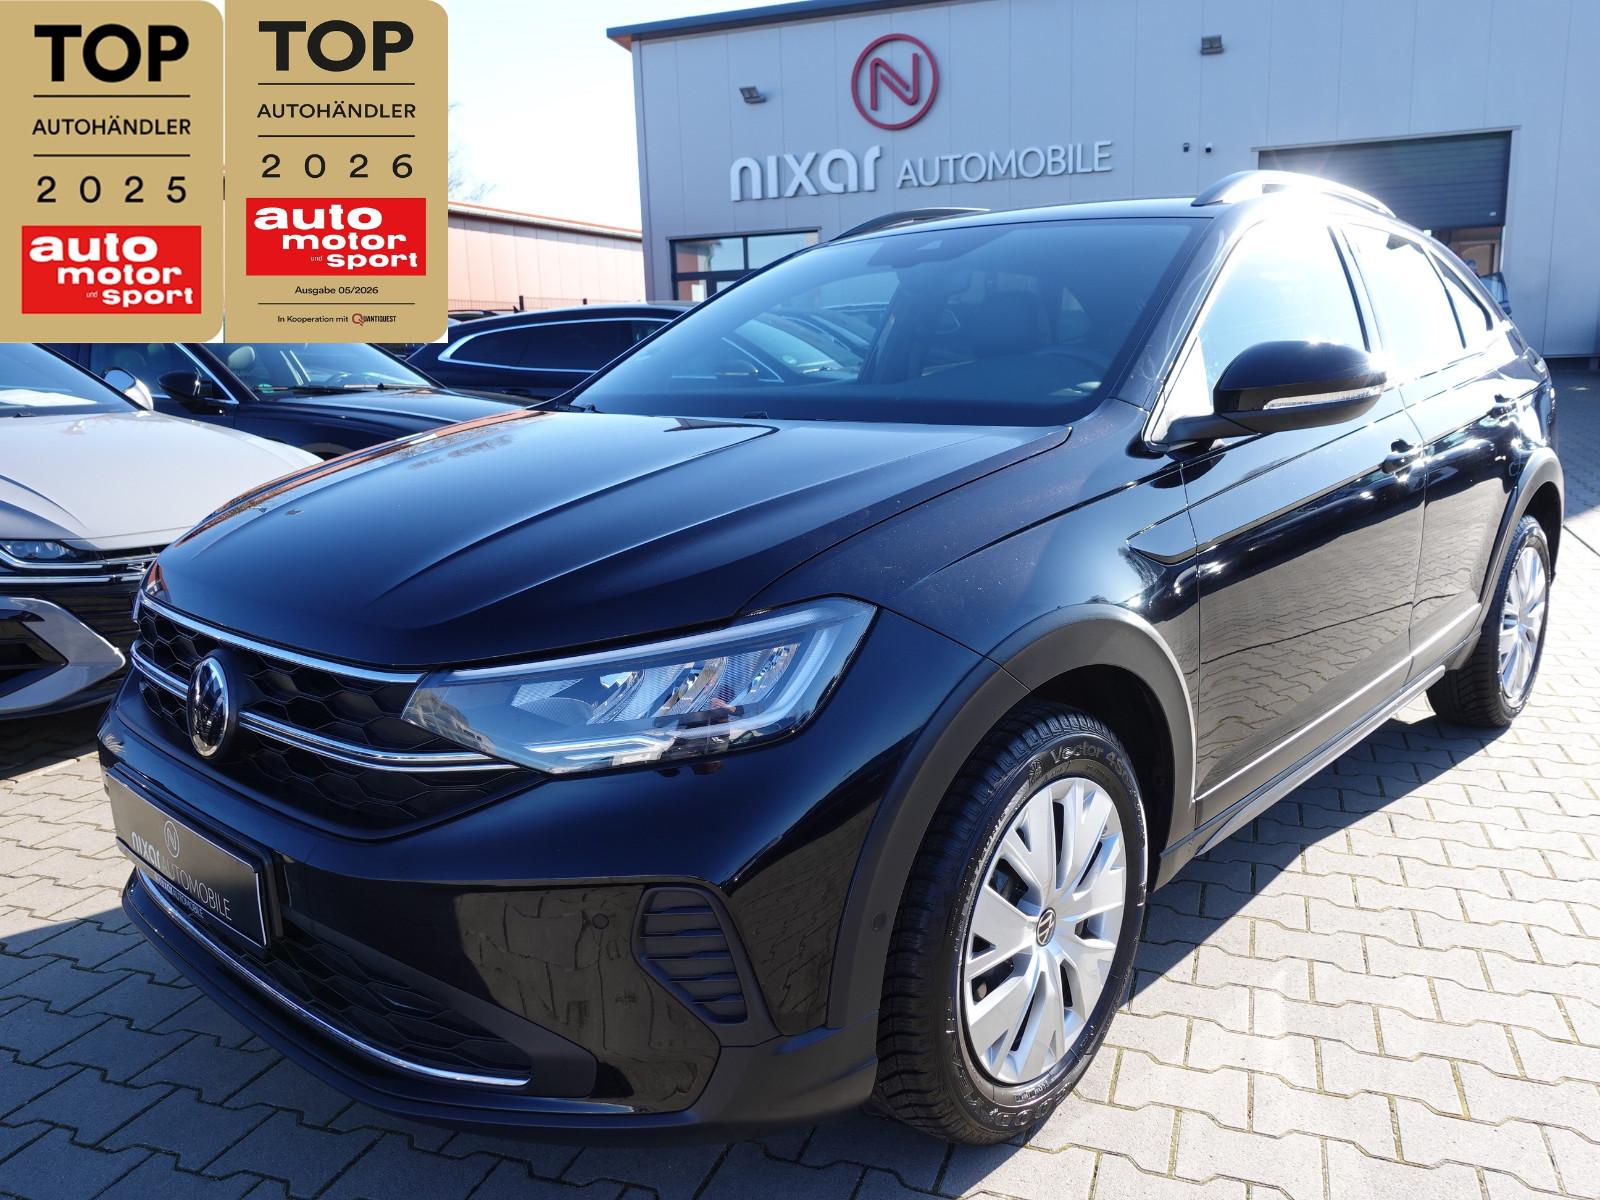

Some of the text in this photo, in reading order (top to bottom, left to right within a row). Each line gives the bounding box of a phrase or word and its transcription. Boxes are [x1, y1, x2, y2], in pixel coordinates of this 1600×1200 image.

[729, 140, 1112, 202] nixar AUTOMOBILE
[1050, 741, 1104, 764] Vector
[131, 831, 160, 869] nixar
[161, 856, 232, 921] AUTOMOBILE
